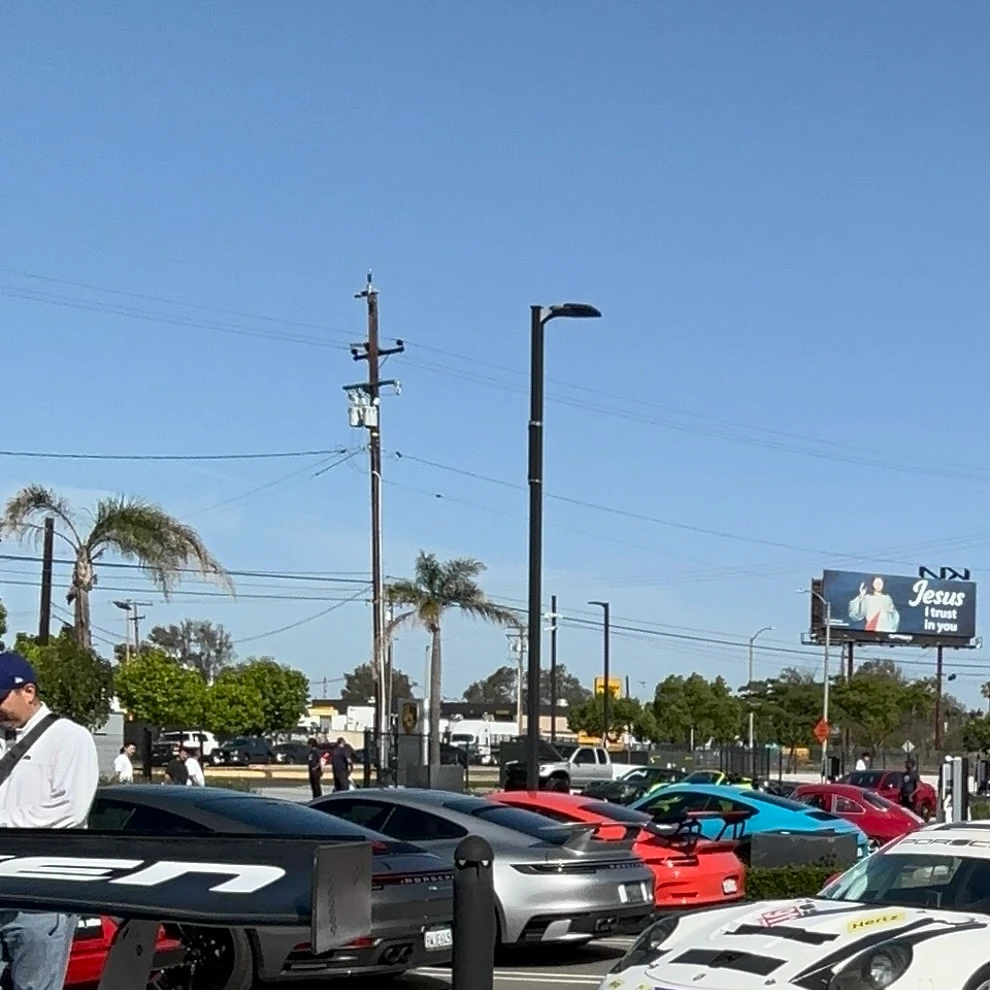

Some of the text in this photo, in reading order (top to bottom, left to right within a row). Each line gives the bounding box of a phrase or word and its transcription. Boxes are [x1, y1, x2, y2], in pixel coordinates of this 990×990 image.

[908, 580, 966, 607] Jesus
[924, 607, 957, 619] I trust
[924, 619, 958, 634] in you
[852, 914, 898, 929] Hertz
